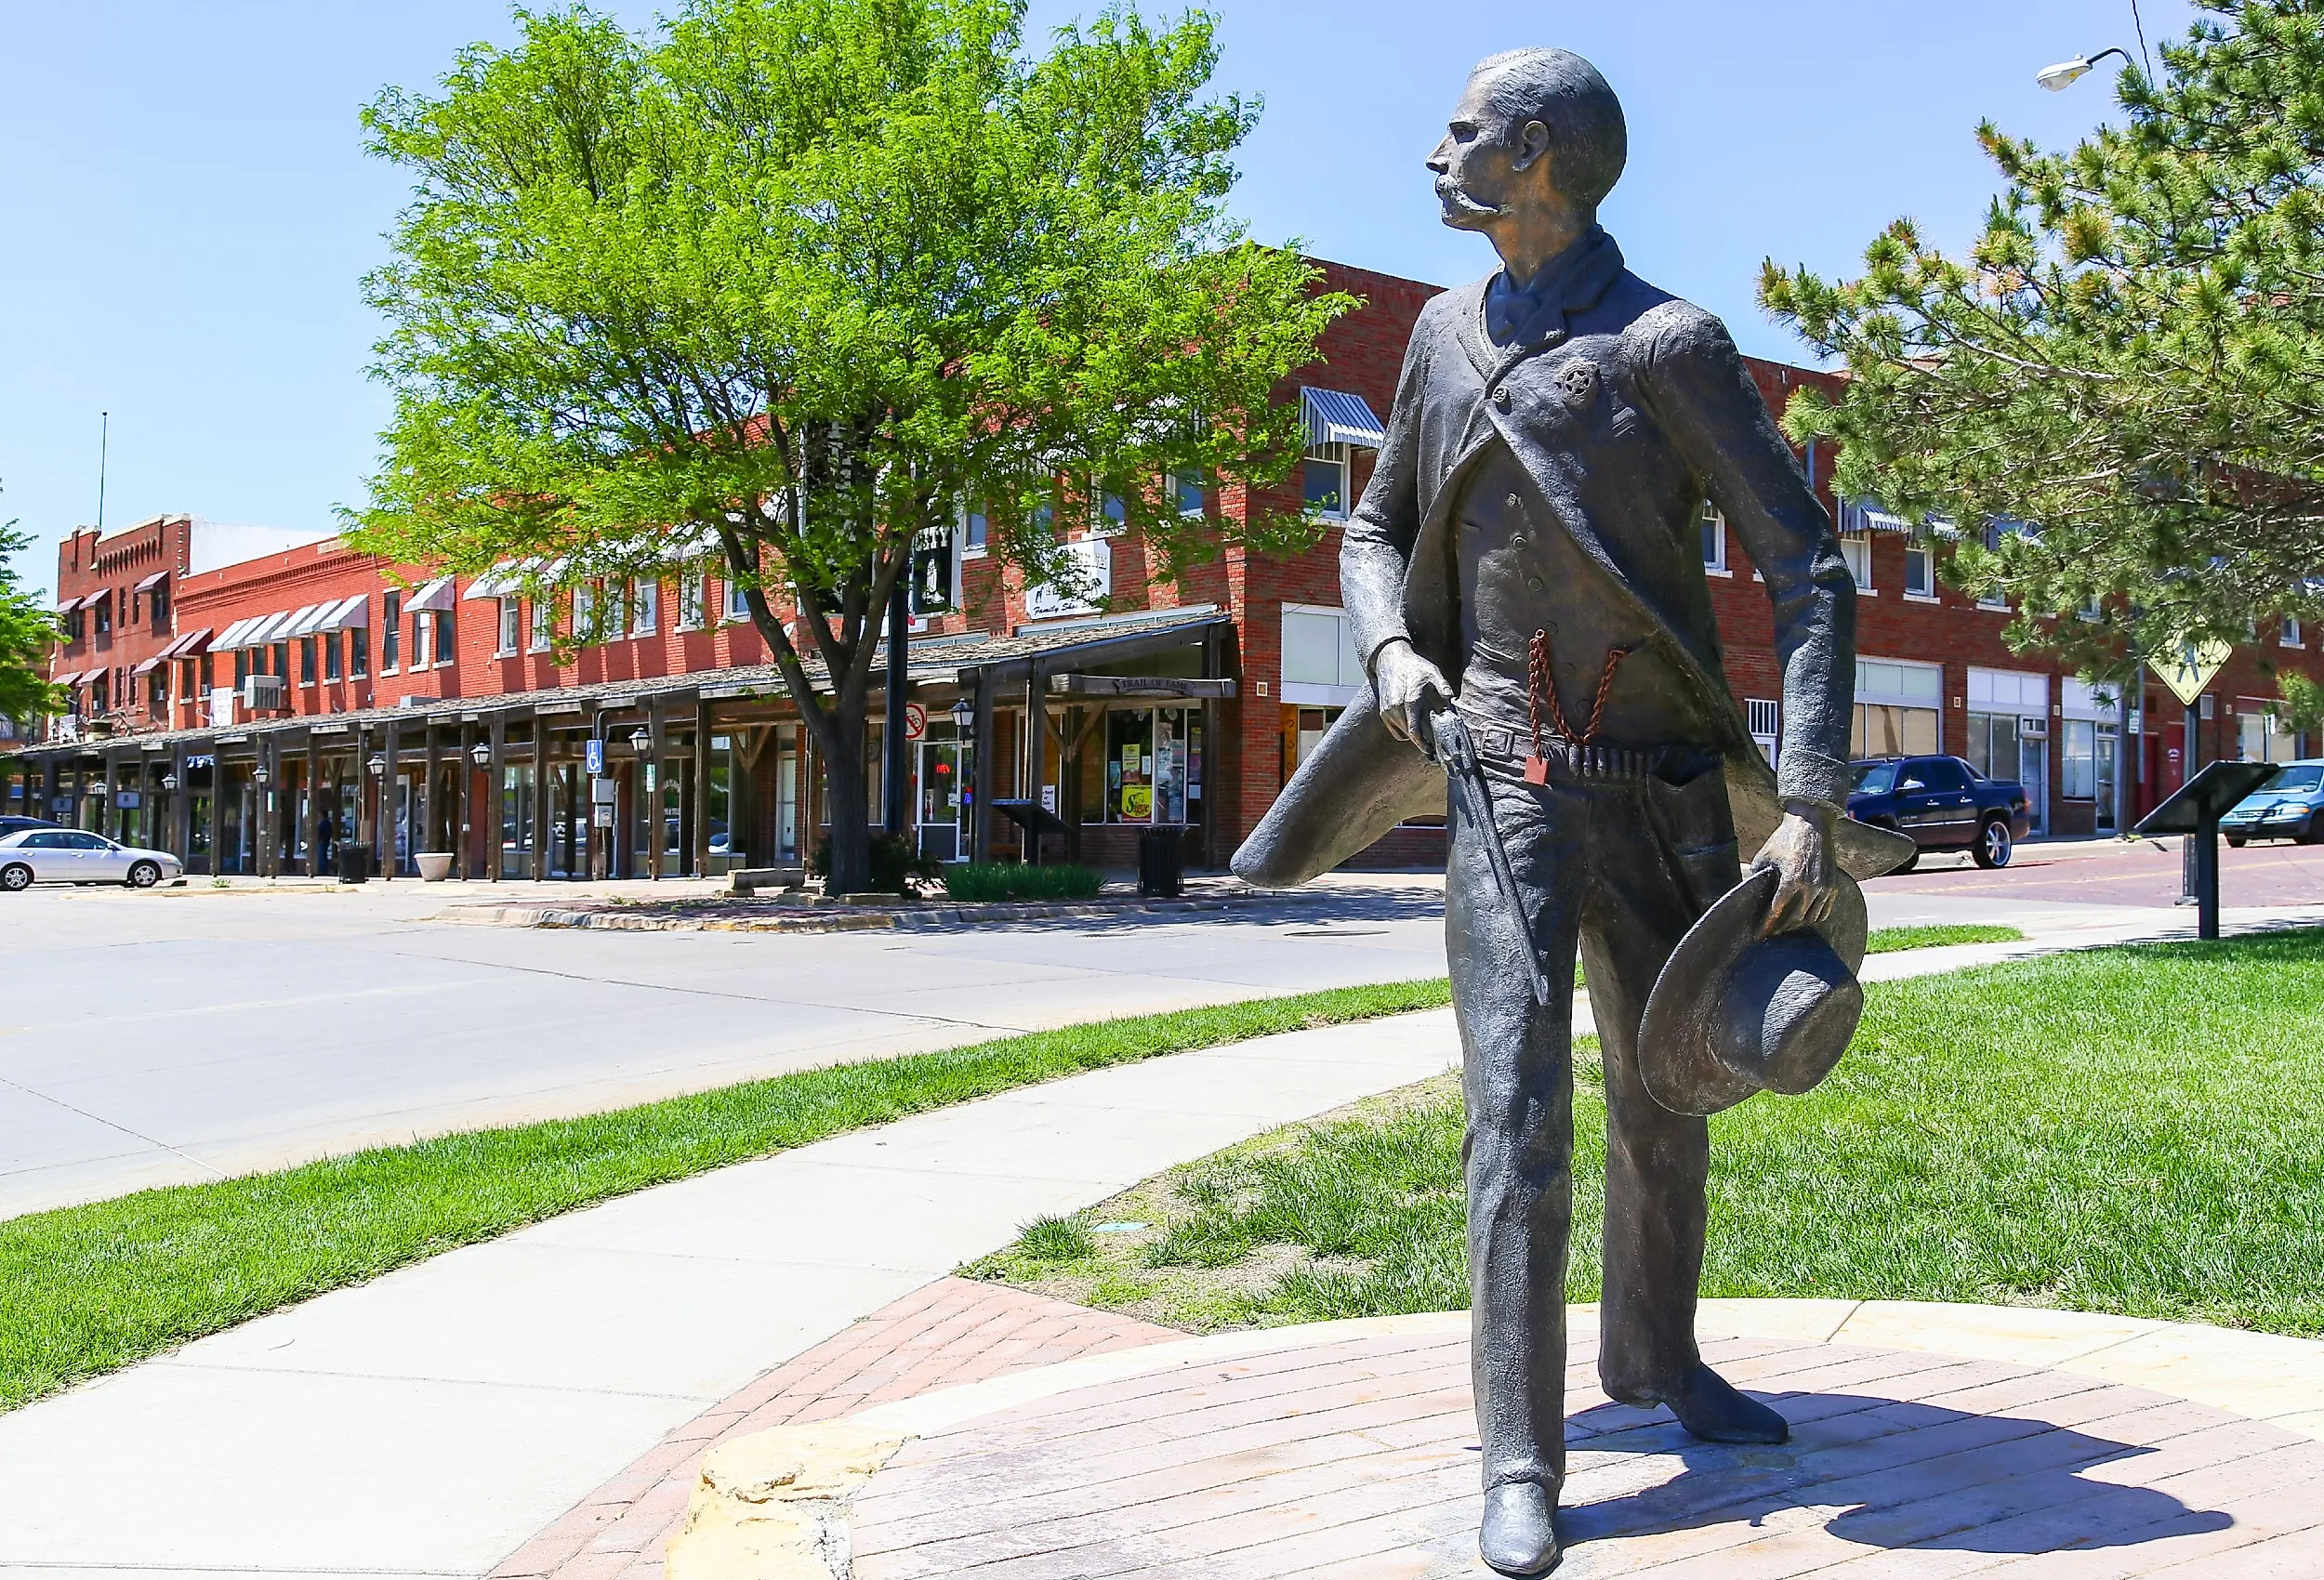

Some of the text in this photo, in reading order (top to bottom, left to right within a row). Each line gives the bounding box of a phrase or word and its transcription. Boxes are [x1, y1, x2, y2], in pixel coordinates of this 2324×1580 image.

[1033, 605, 1059, 615] Family
[1122, 678, 1187, 691] TRAIL OF FAME
[936, 764, 950, 773] OPEN
